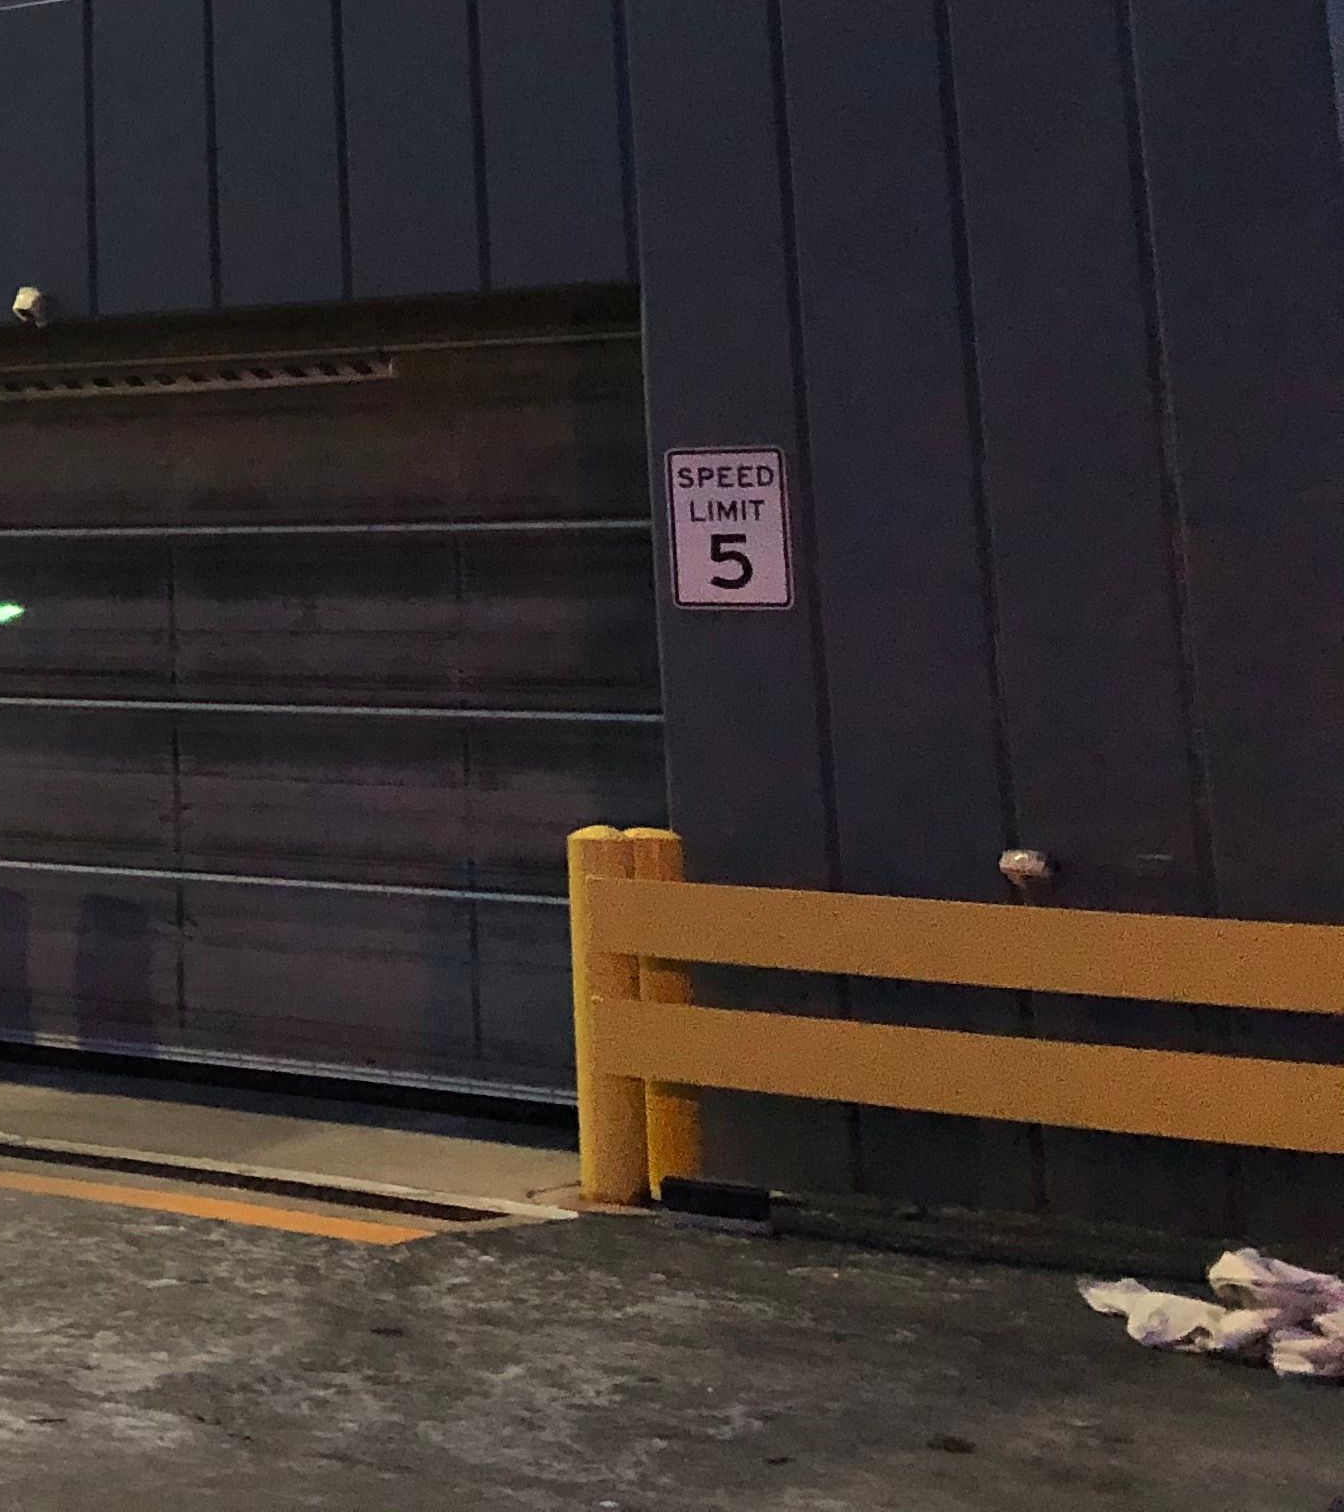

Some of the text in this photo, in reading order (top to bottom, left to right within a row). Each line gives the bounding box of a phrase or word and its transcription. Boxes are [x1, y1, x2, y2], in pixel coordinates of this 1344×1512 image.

[677, 464, 775, 489] SPEED
[689, 498, 765, 523] LIMIT
[710, 532, 754, 590] 5
